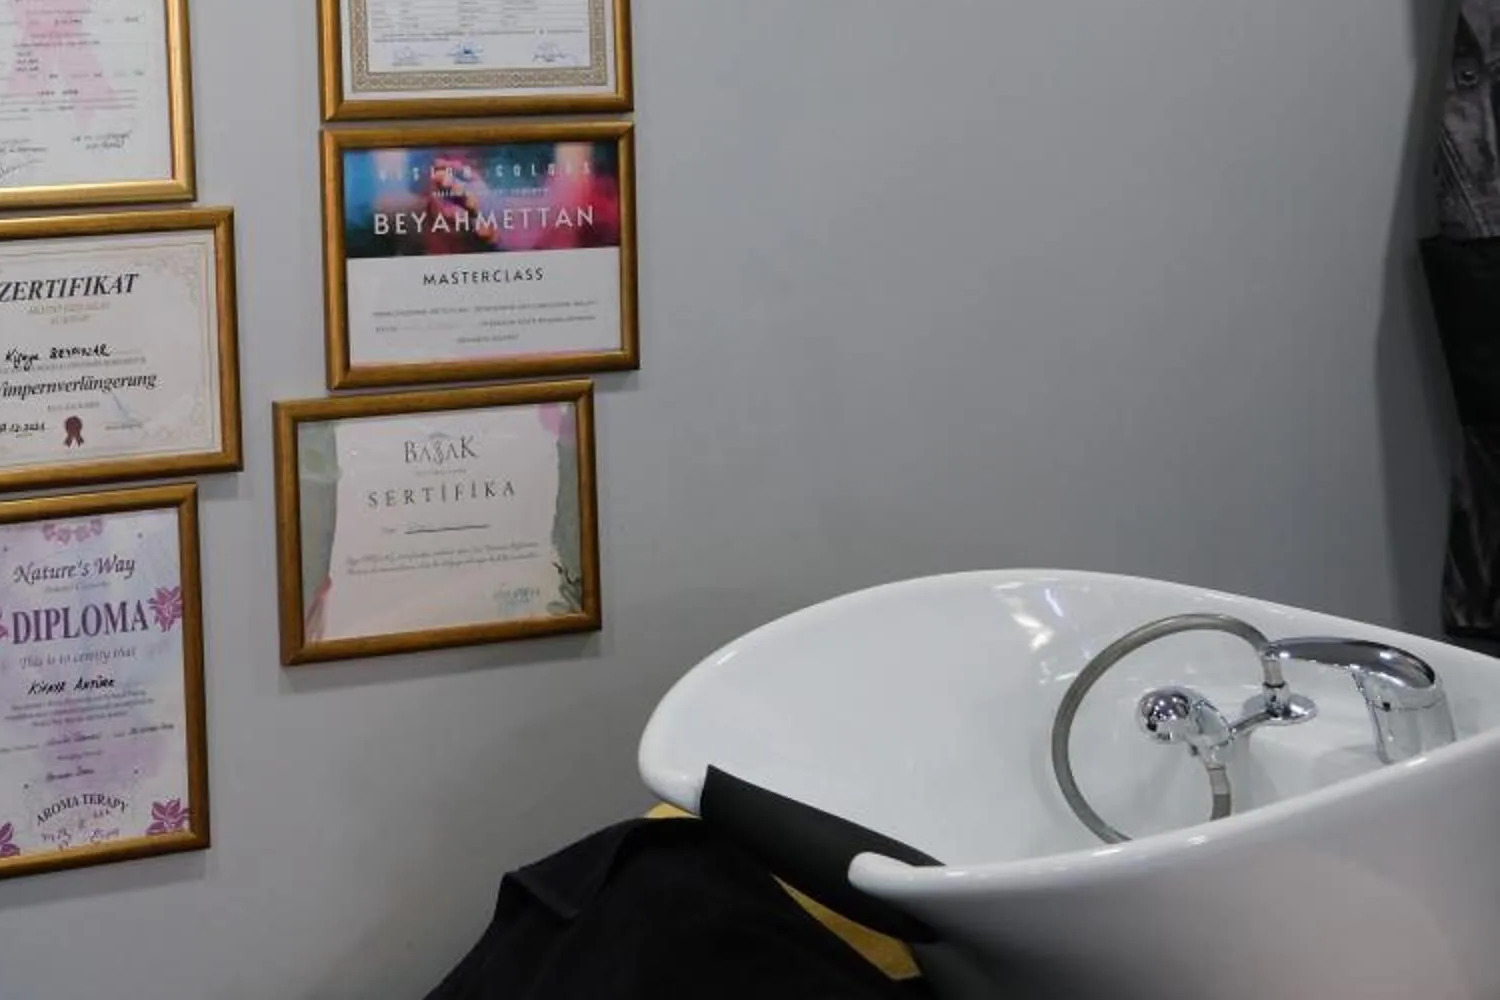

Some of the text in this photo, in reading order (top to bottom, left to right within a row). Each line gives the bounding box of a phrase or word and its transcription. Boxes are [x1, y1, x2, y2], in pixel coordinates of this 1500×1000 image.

[373, 205, 594, 236] BEYAHMETTAN
[423, 267, 545, 286] MASTERCLASS
[368, 480, 516, 508] SERTİFİKA
[13, 553, 136, 585] Nature's Way
[11, 599, 149, 645] DIPLOMA
[36, 795, 80, 826] AROMA
